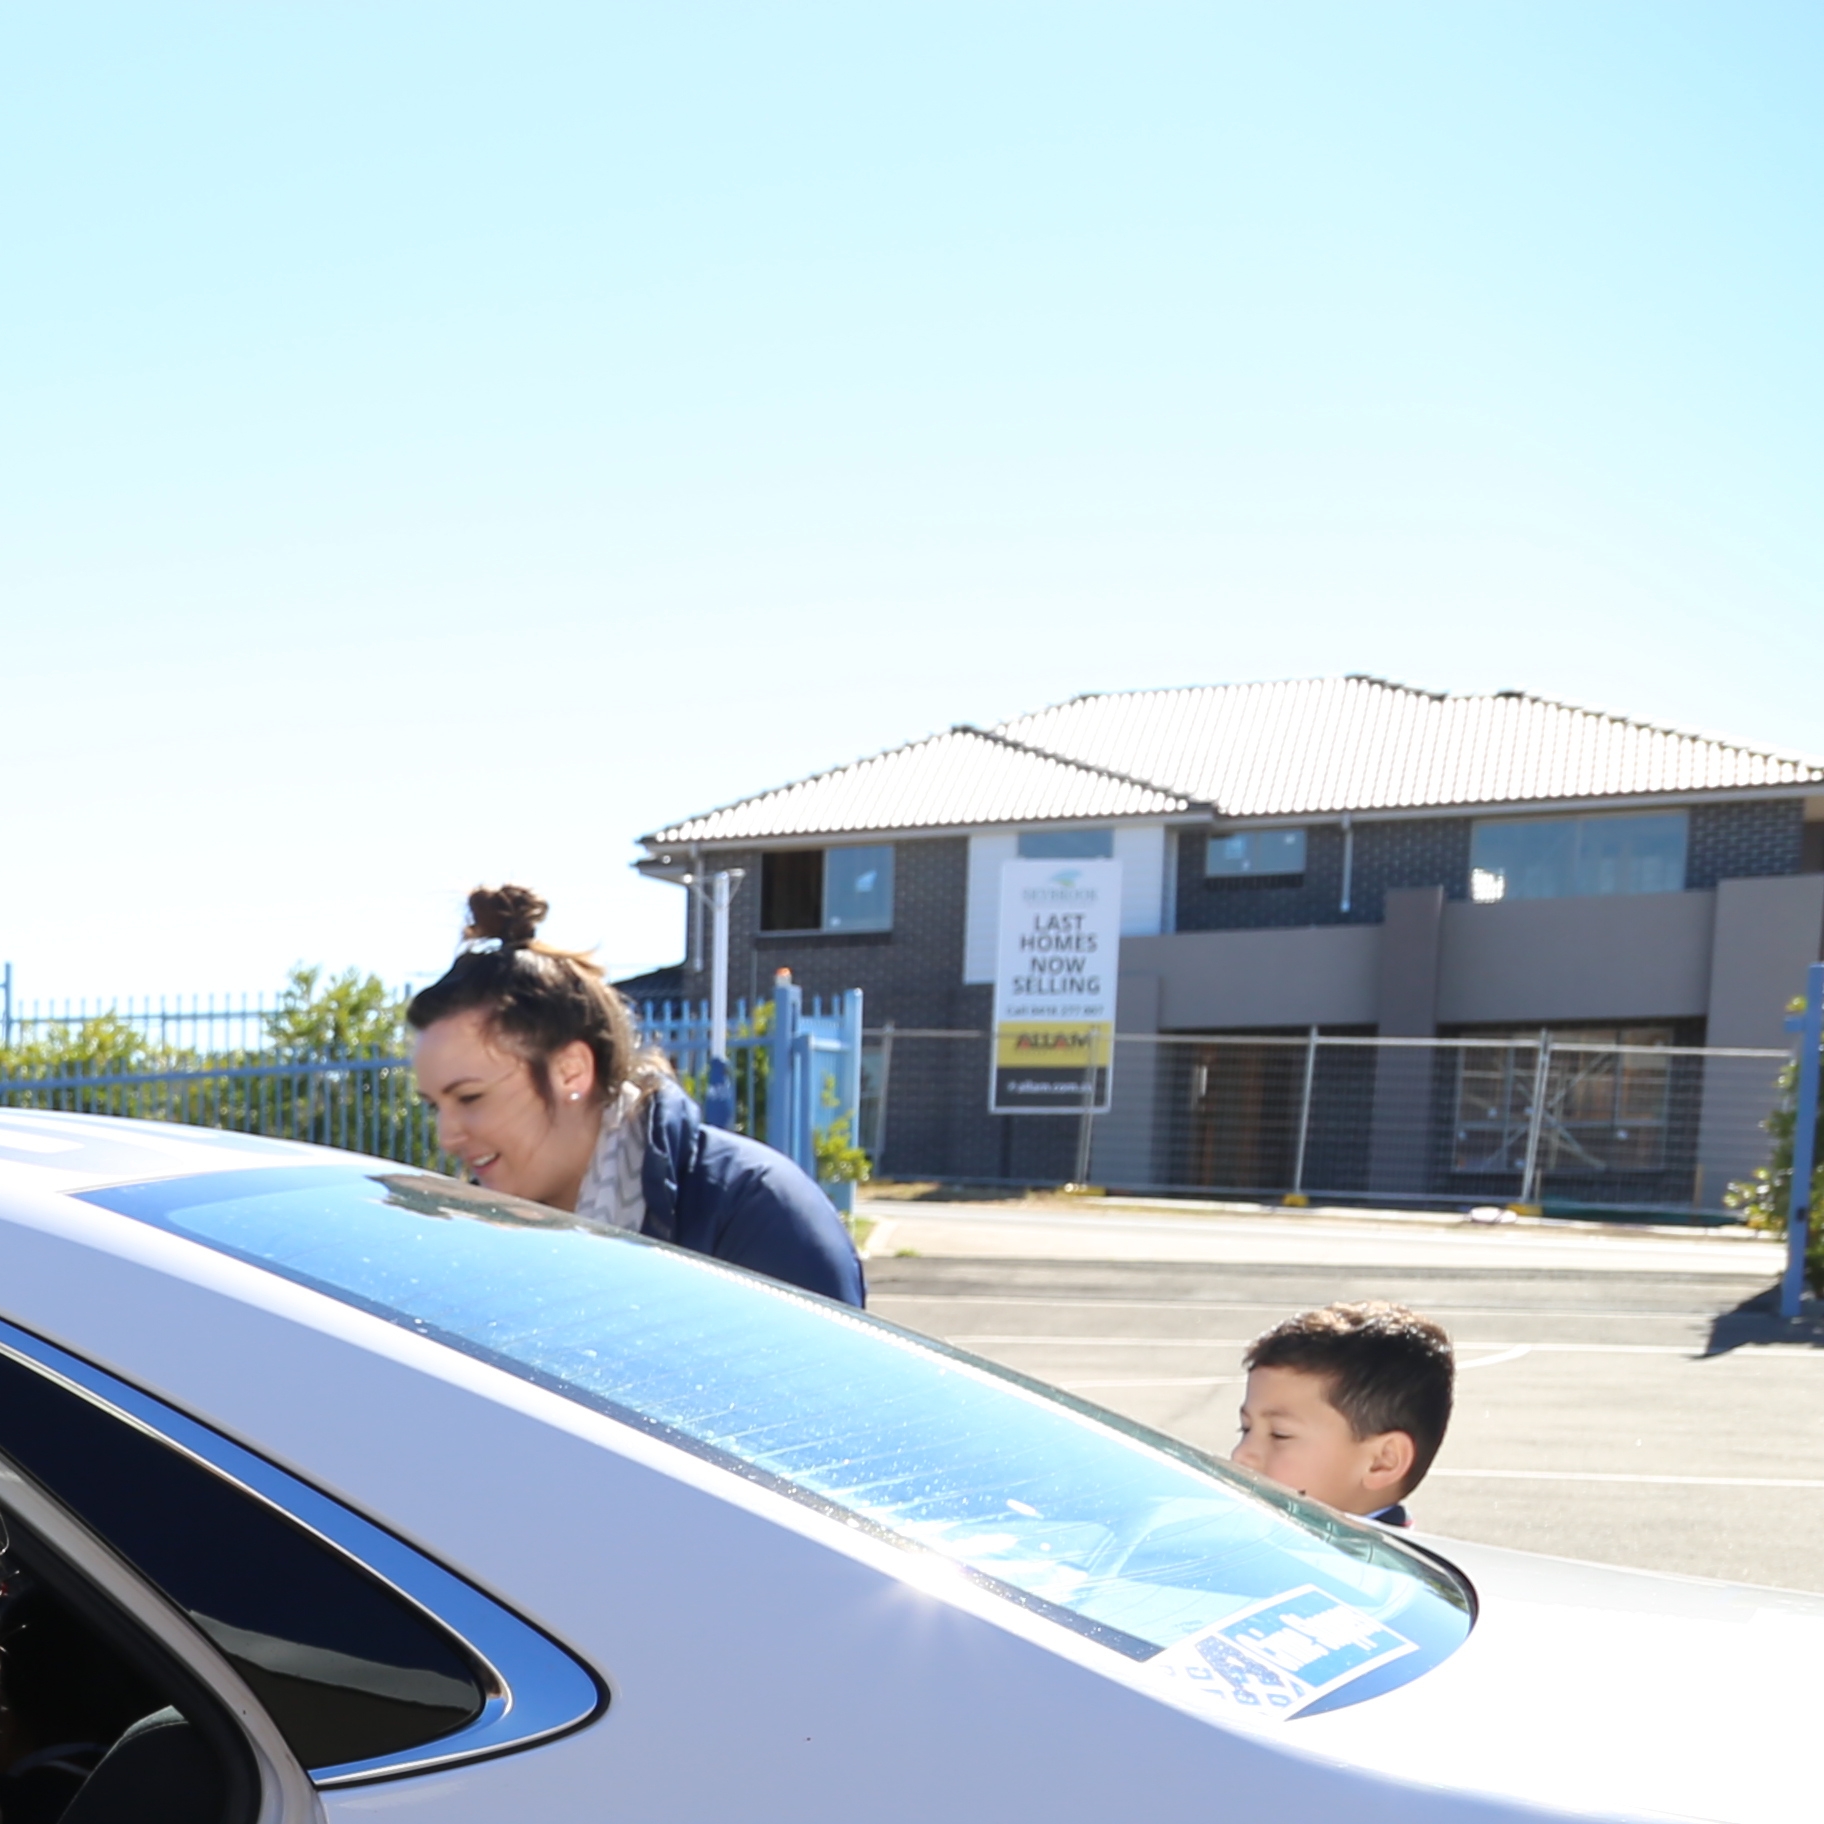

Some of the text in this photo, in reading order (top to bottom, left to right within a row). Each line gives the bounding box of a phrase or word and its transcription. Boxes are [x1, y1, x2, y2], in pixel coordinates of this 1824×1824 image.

[1033, 914, 1086, 932] LAST
[1020, 934, 1098, 952] HOMES
[1031, 957, 1085, 974] NOW
[1013, 975, 1101, 996] SELLING
[1015, 1033, 1091, 1050] ALLAM
